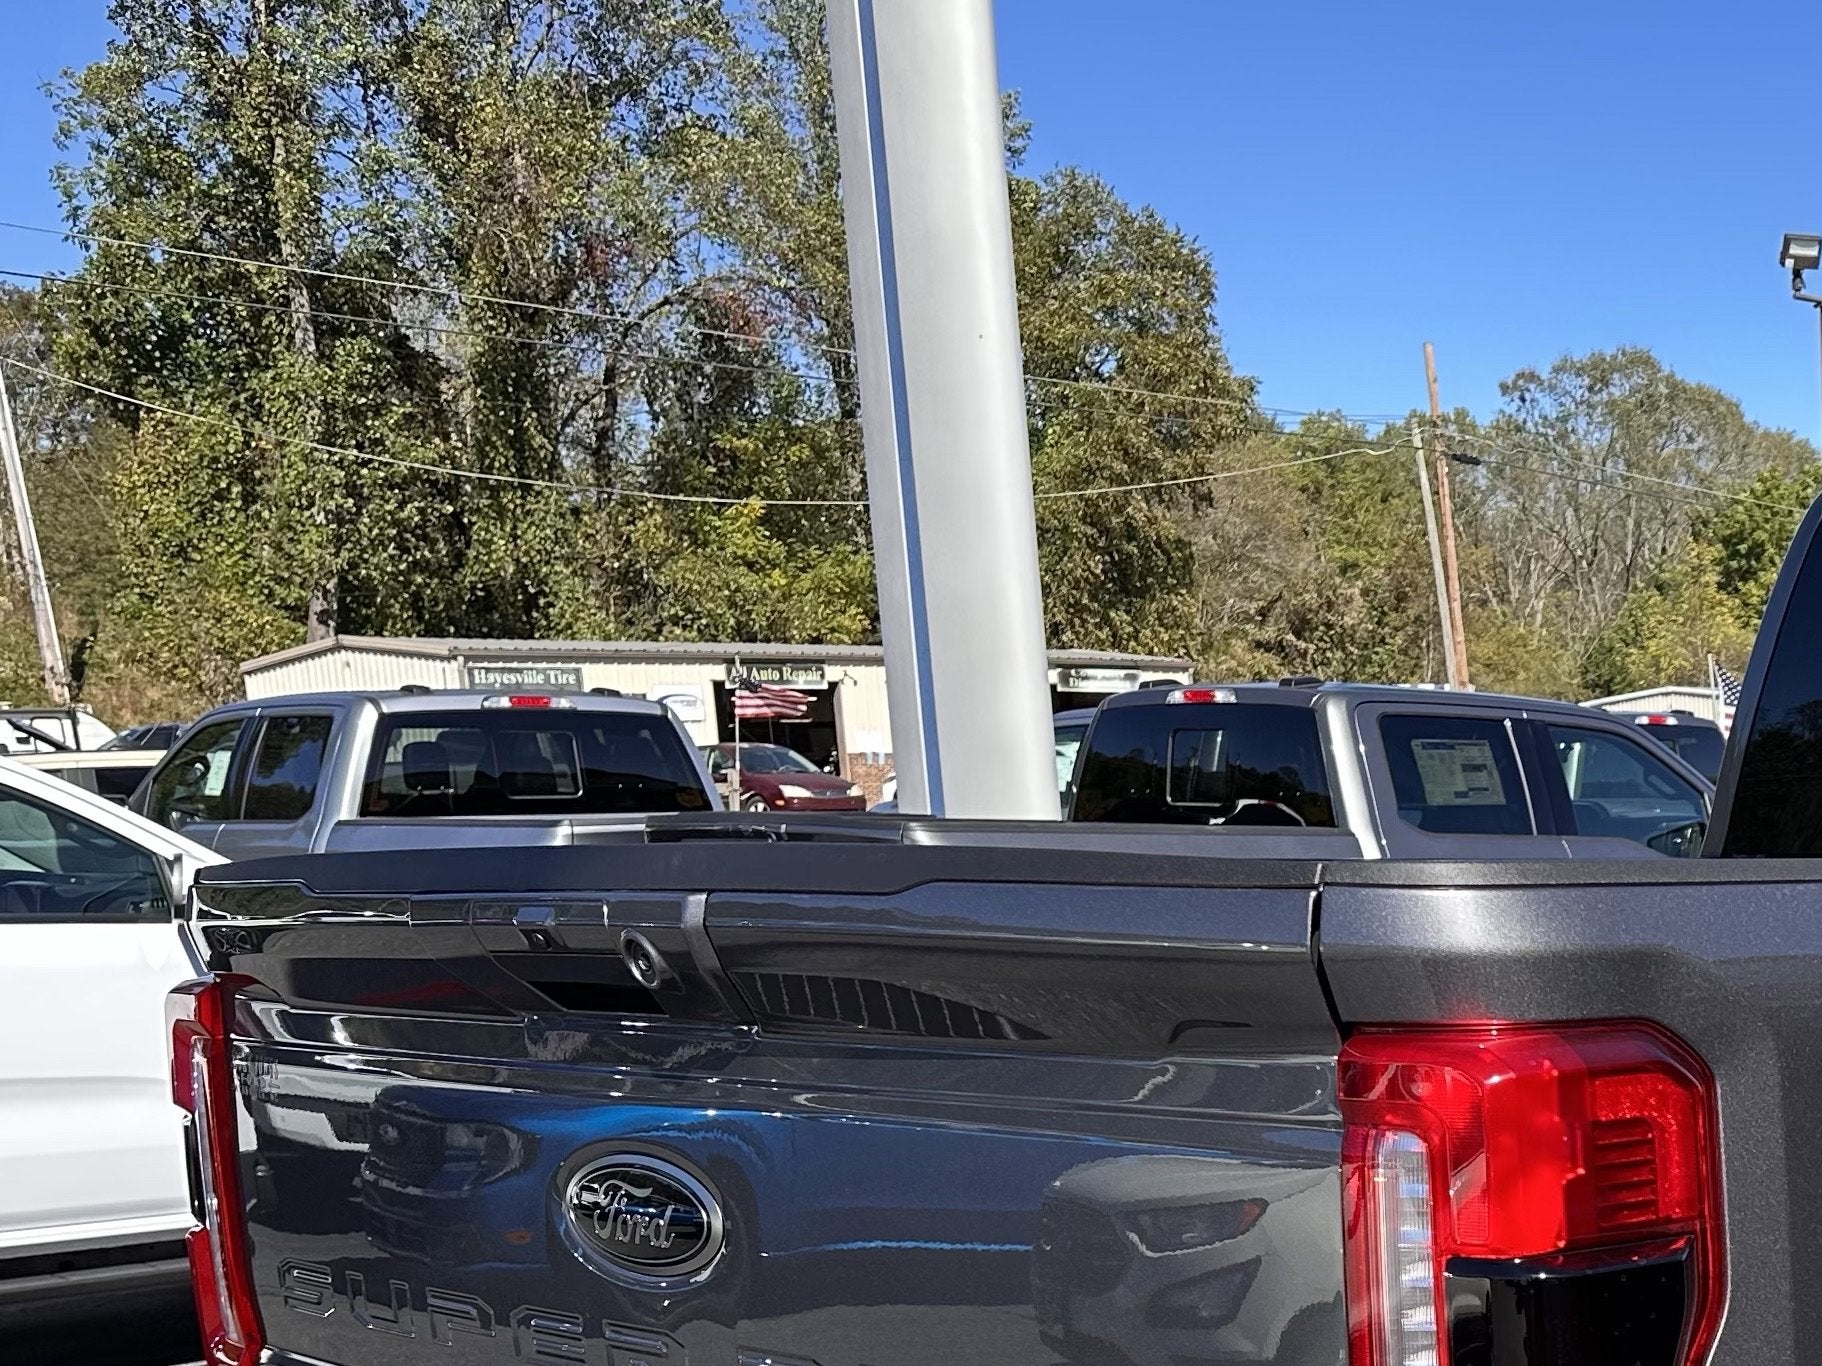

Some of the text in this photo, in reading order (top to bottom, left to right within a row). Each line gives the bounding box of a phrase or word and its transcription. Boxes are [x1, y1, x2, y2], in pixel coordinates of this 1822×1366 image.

[473, 668, 577, 688] Hayesville Tire
[750, 666, 780, 681] Auto
[782, 666, 823, 684] Repair
[592, 1179, 677, 1249] Ford
